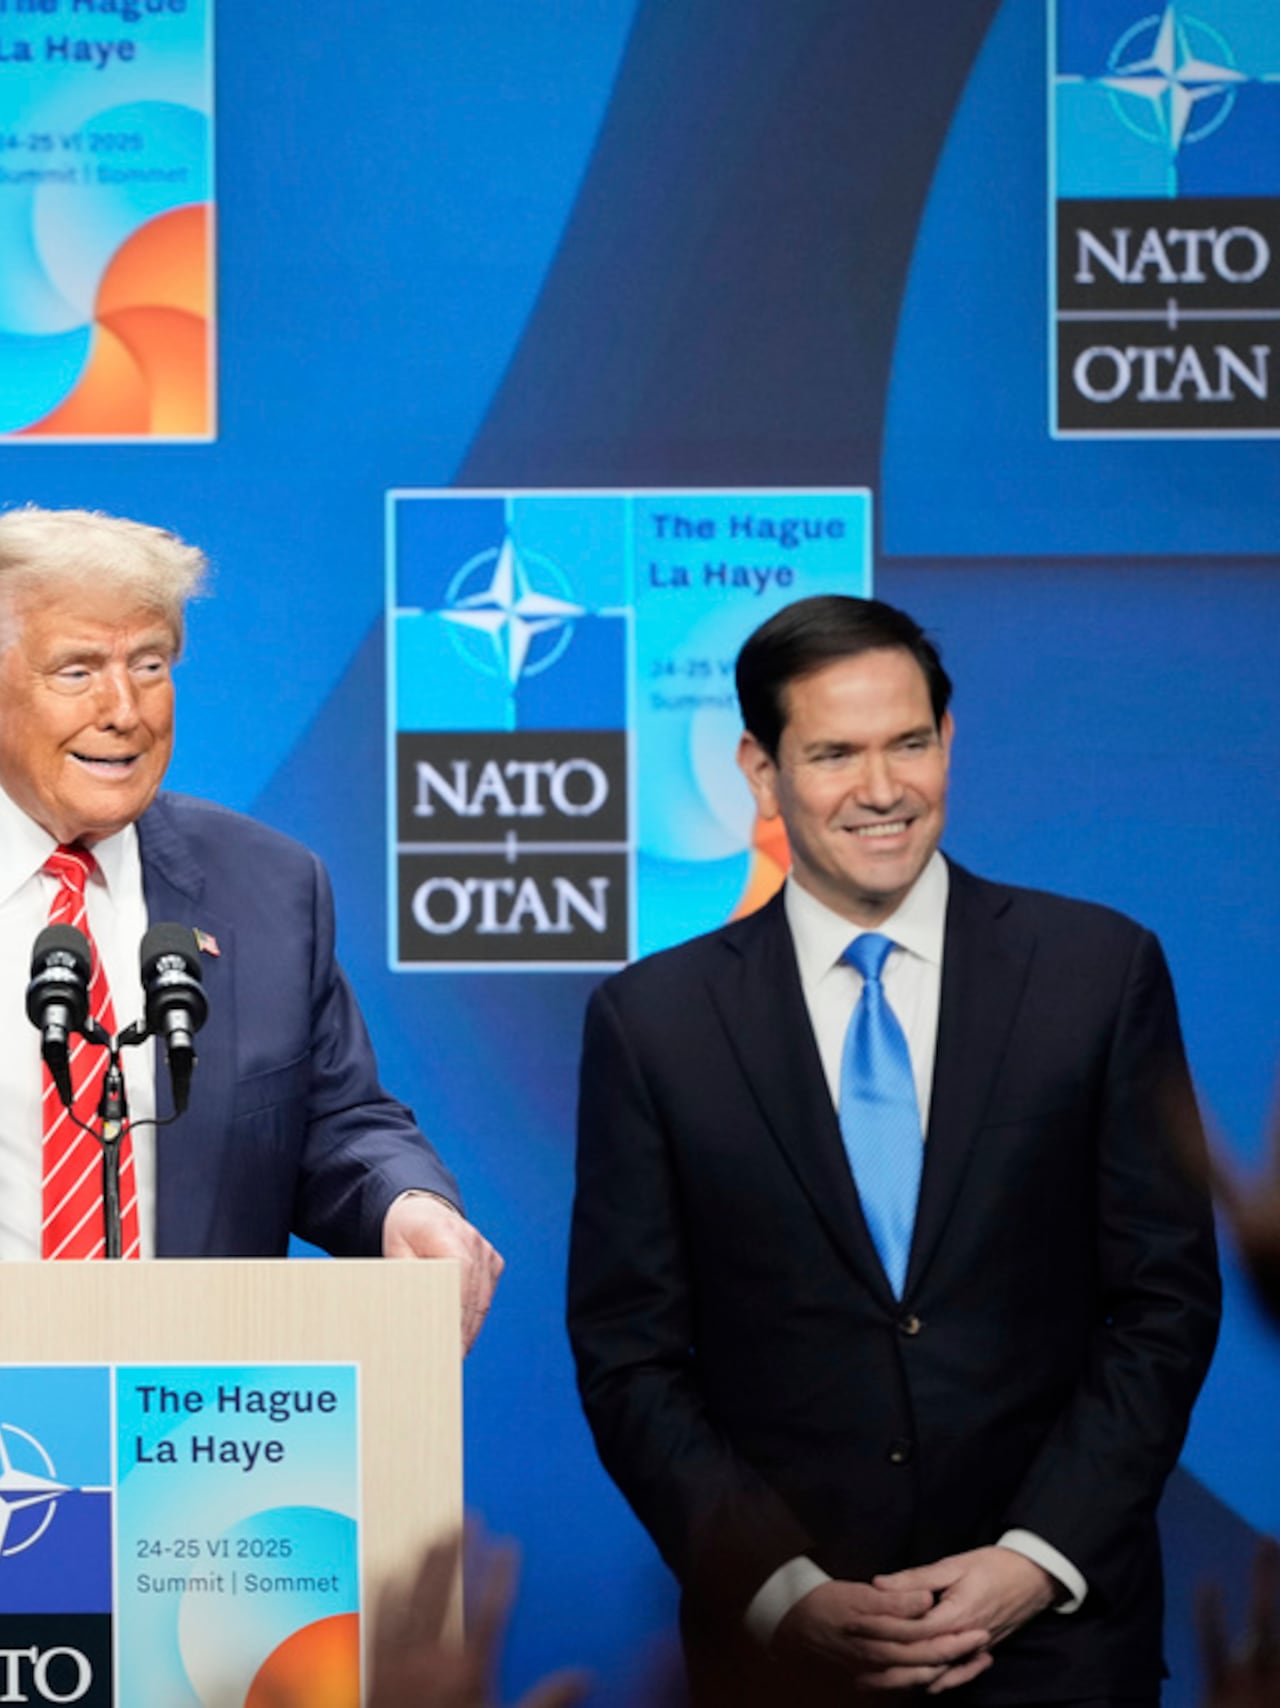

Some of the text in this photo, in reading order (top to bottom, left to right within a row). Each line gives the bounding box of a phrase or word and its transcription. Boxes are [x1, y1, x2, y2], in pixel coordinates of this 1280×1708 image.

[46, 36, 136, 70] Haye
[89, 132, 144, 152] 2025
[1074, 226, 1271, 284] NATO
[1072, 345, 1271, 403] OTAN
[652, 513, 845, 550] The Hague
[649, 561, 794, 596] La Haye
[414, 759, 609, 816] NATO
[412, 876, 610, 934] OTAN
[136, 1386, 337, 1422] The Hague
[136, 1436, 285, 1471] La Haye
[136, 1539, 292, 1558] 24-25 VI 2025
[136, 1573, 224, 1593] Summit
[244, 1574, 340, 1593] Sommet
